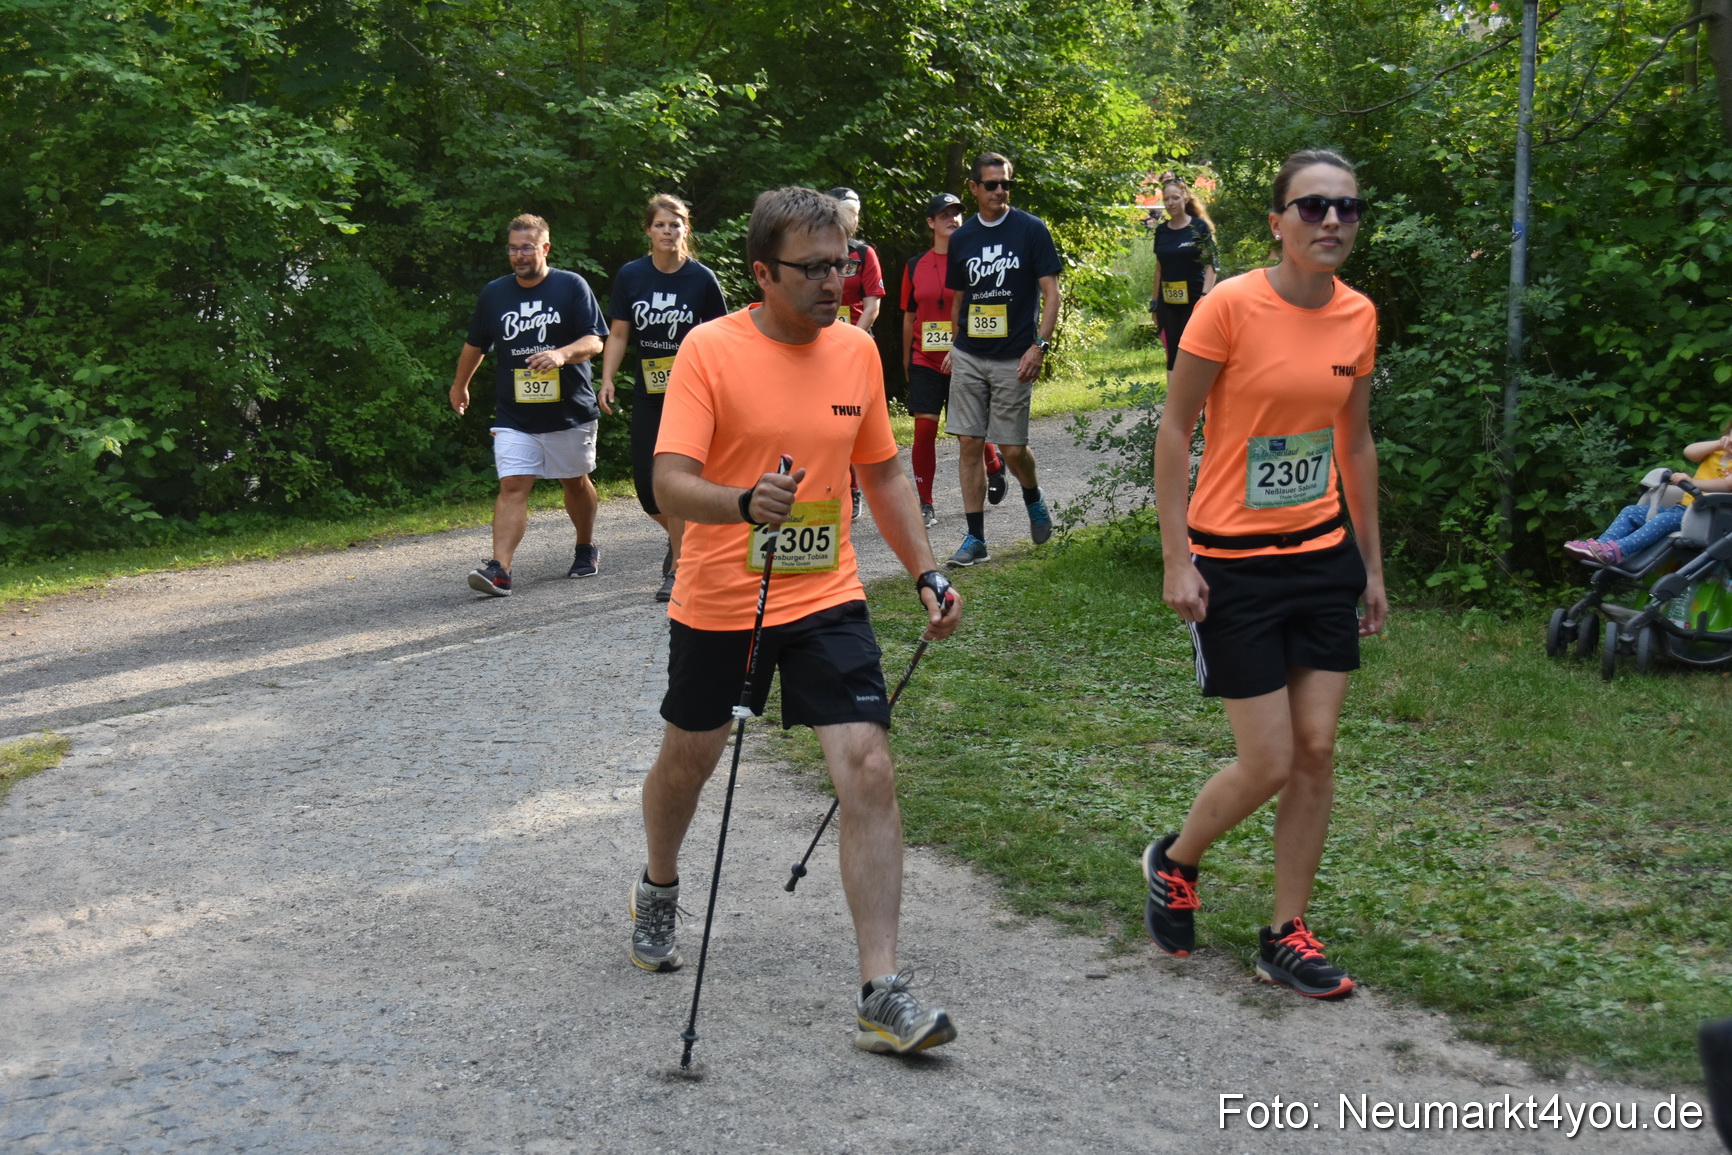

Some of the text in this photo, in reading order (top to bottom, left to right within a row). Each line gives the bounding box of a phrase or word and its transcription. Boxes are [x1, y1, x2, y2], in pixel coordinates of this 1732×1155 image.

[966, 251, 1020, 288] Burgis
[500, 306, 561, 343] Burgis
[632, 301, 694, 340] Burgis
[974, 316, 997, 329] 385
[640, 340, 681, 351] Knödellieb
[1331, 365, 1357, 377] THUL
[524, 381, 550, 394] 397
[831, 404, 862, 417] THULE
[1257, 455, 1323, 488] 2307
[1264, 487, 1297, 496] Neßlauer
[761, 553, 829, 562] Mosburger Tobias
